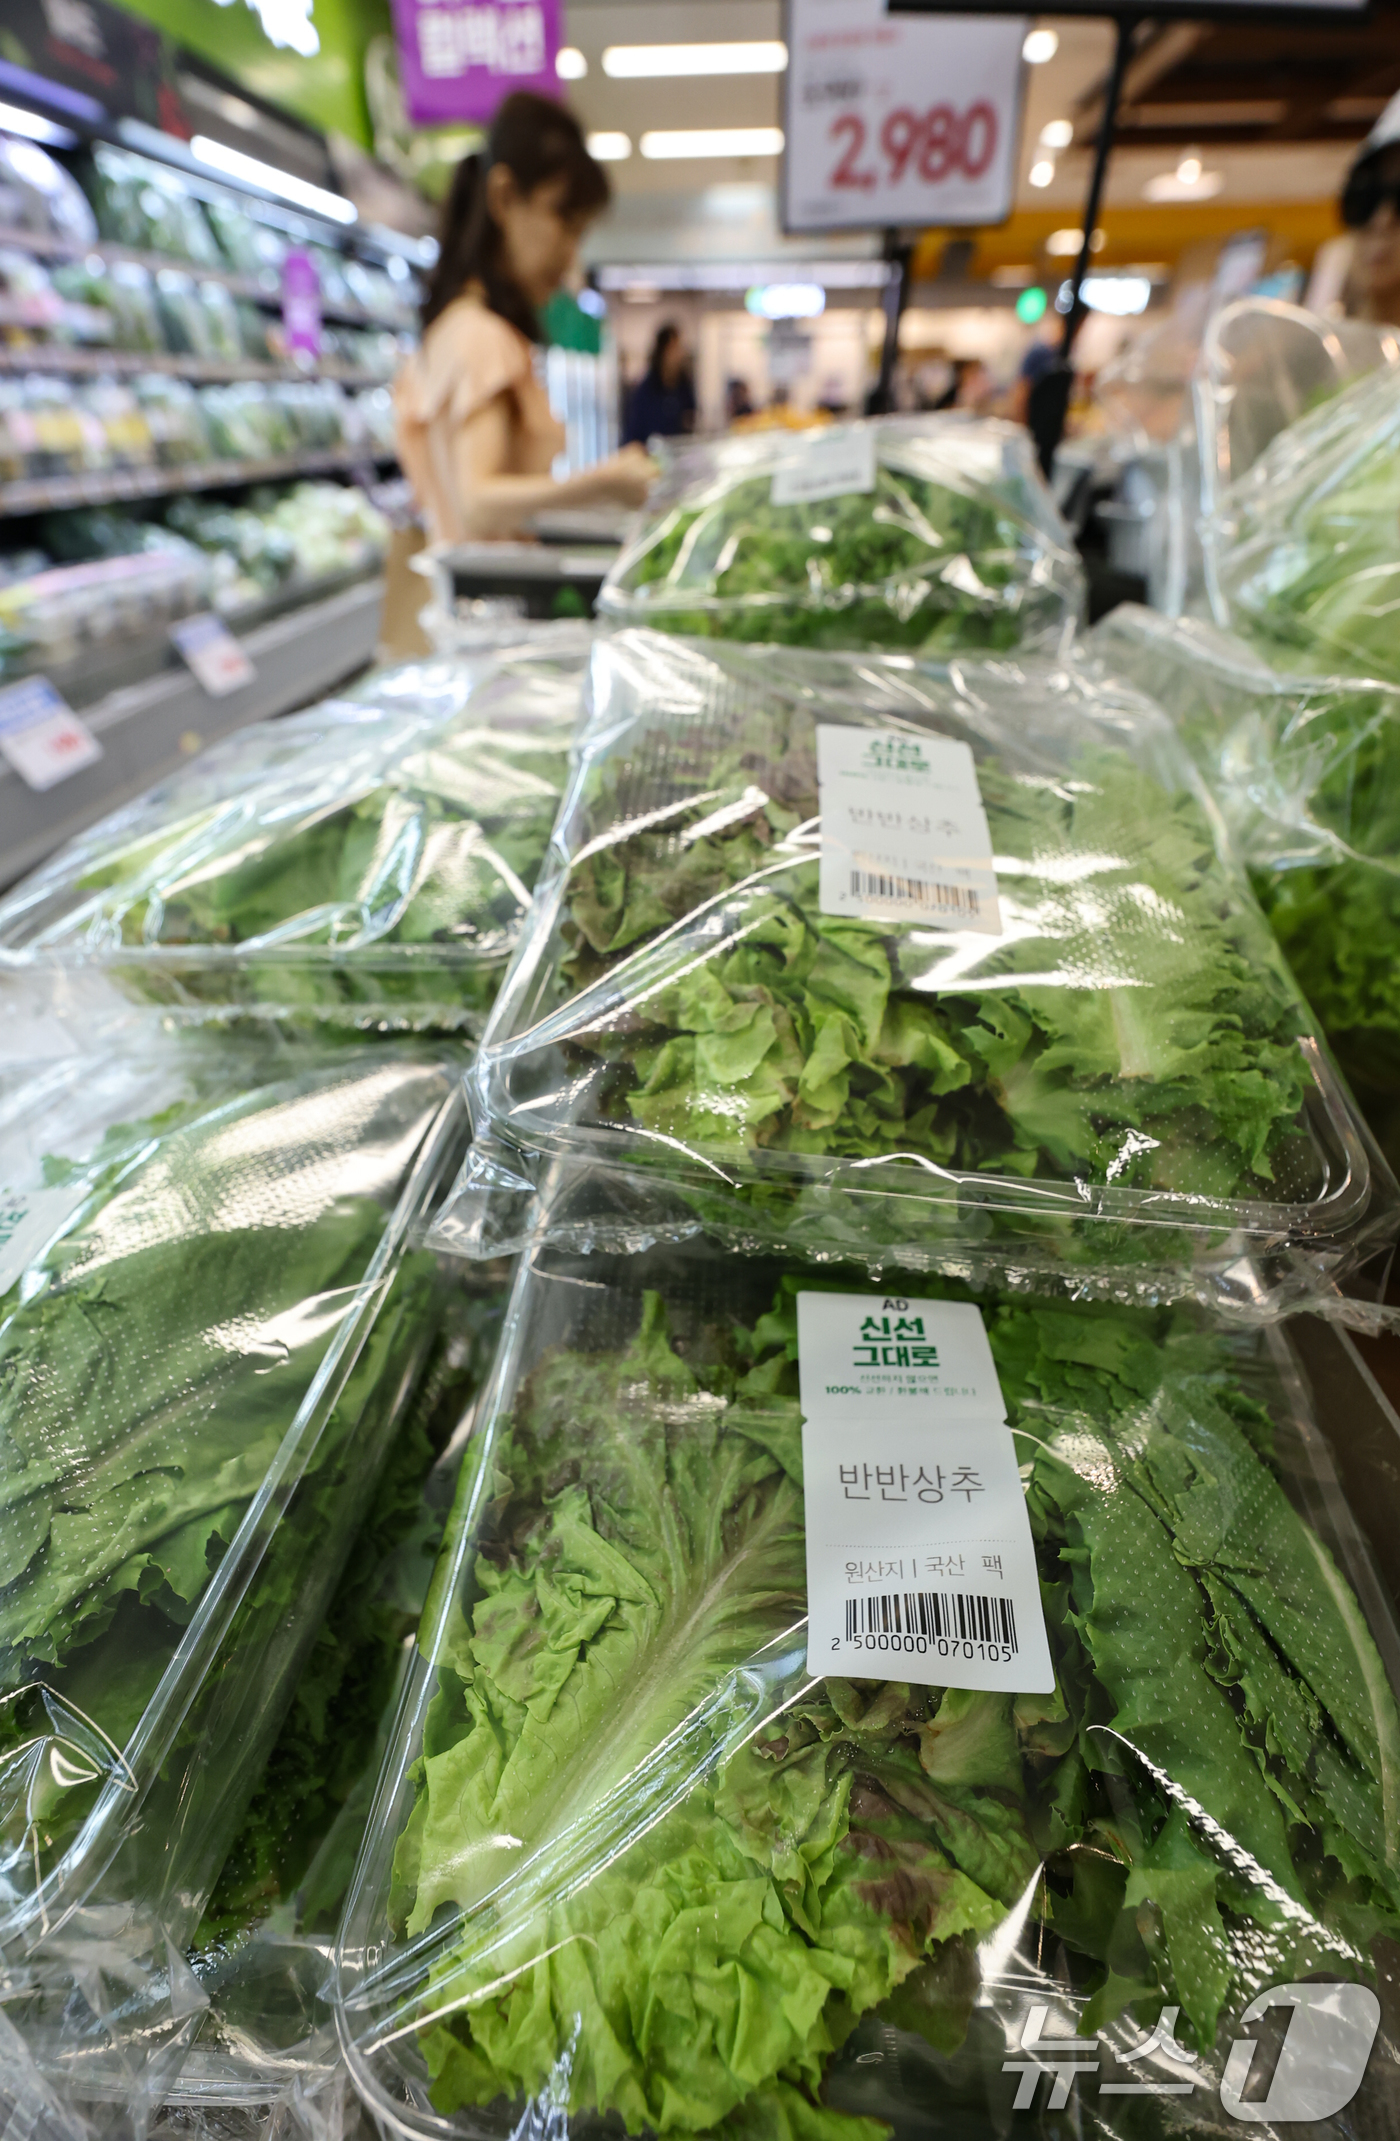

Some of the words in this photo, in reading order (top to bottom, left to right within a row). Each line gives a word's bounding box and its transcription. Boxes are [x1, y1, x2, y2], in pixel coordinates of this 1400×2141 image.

[827, 98, 998, 194] 2,980
[882, 1298, 909, 1312] AD
[860, 1316, 926, 1342] 신선
[853, 1346, 940, 1367] 그대로
[825, 1385, 861, 1395] 100%
[838, 1462, 985, 1503] 반반상추
[844, 1559, 904, 1584] 원산지
[924, 1554, 966, 1577] 국산
[981, 1554, 1003, 1580] 팩
[831, 1637, 840, 1651] 2
[853, 1634, 927, 1654] 500000
[938, 1639, 1012, 1662] 070105
